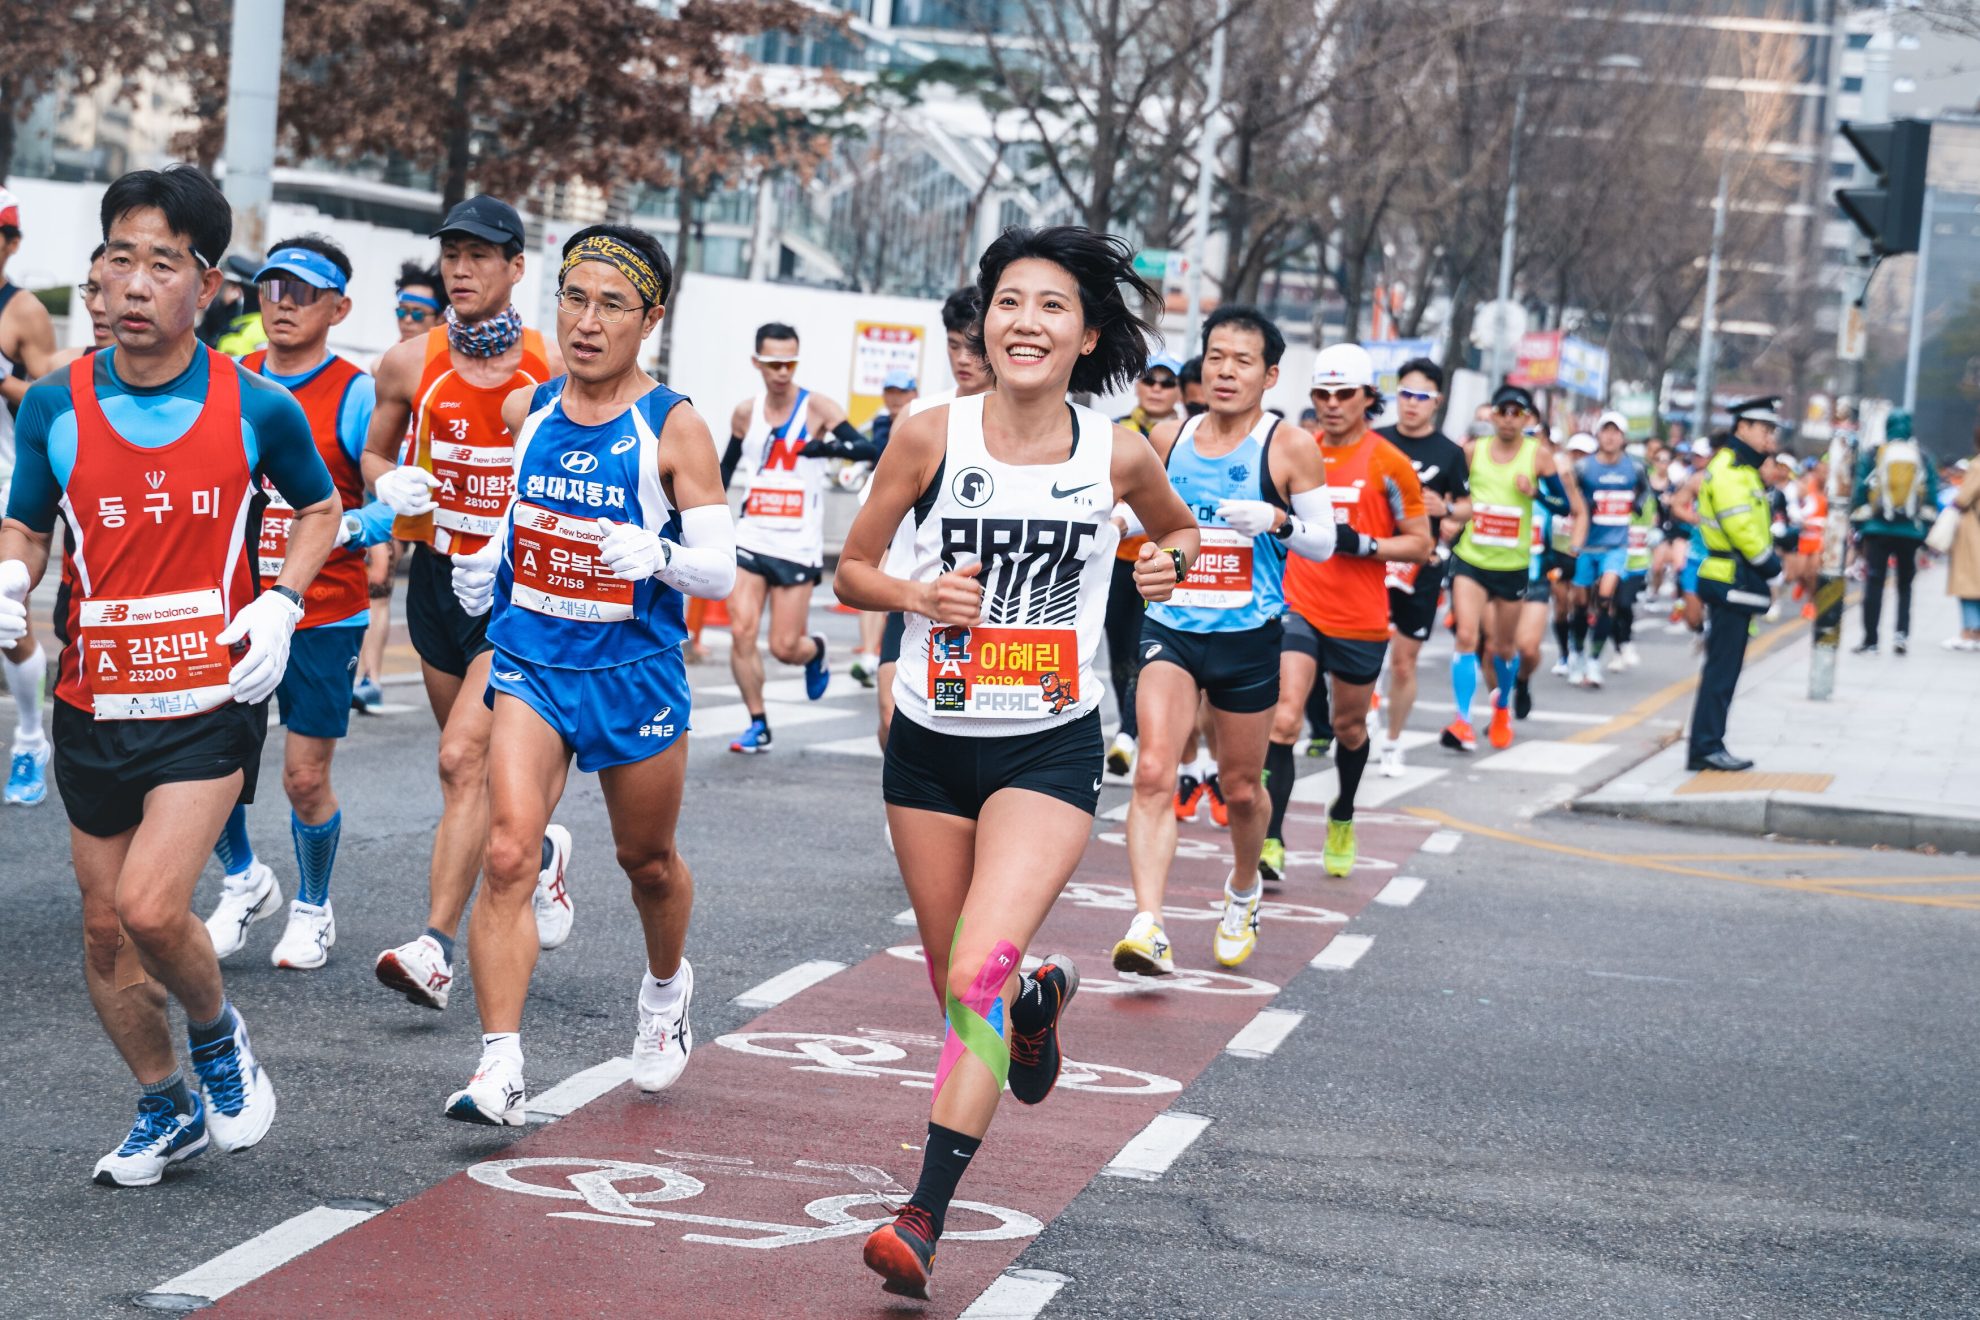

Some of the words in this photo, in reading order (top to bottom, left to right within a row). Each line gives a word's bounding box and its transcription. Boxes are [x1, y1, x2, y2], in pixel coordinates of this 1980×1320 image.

[449, 418, 470, 440] 강
[491, 455, 512, 463] balan
[441, 478, 456, 496] A
[526, 475, 625, 509] 현대자동차
[464, 496, 500, 509] 28100
[559, 527, 575, 537] new
[576, 530, 607, 542] balanc
[522, 549, 538, 571] A
[547, 573, 585, 589] 27158
[132, 612, 152, 621] new
[154, 605, 199, 619] balance
[559, 601, 601, 619] 채널A
[127, 631, 208, 665] 김진만
[97, 651, 118, 673] A
[980, 642, 1060, 672] 이혜린
[129, 667, 176, 682] 23200
[976, 675, 1024, 686] 30194
[150, 693, 199, 714] 채널A
[639, 724, 674, 737] 유복근
[998, 954, 1010, 967] KT
